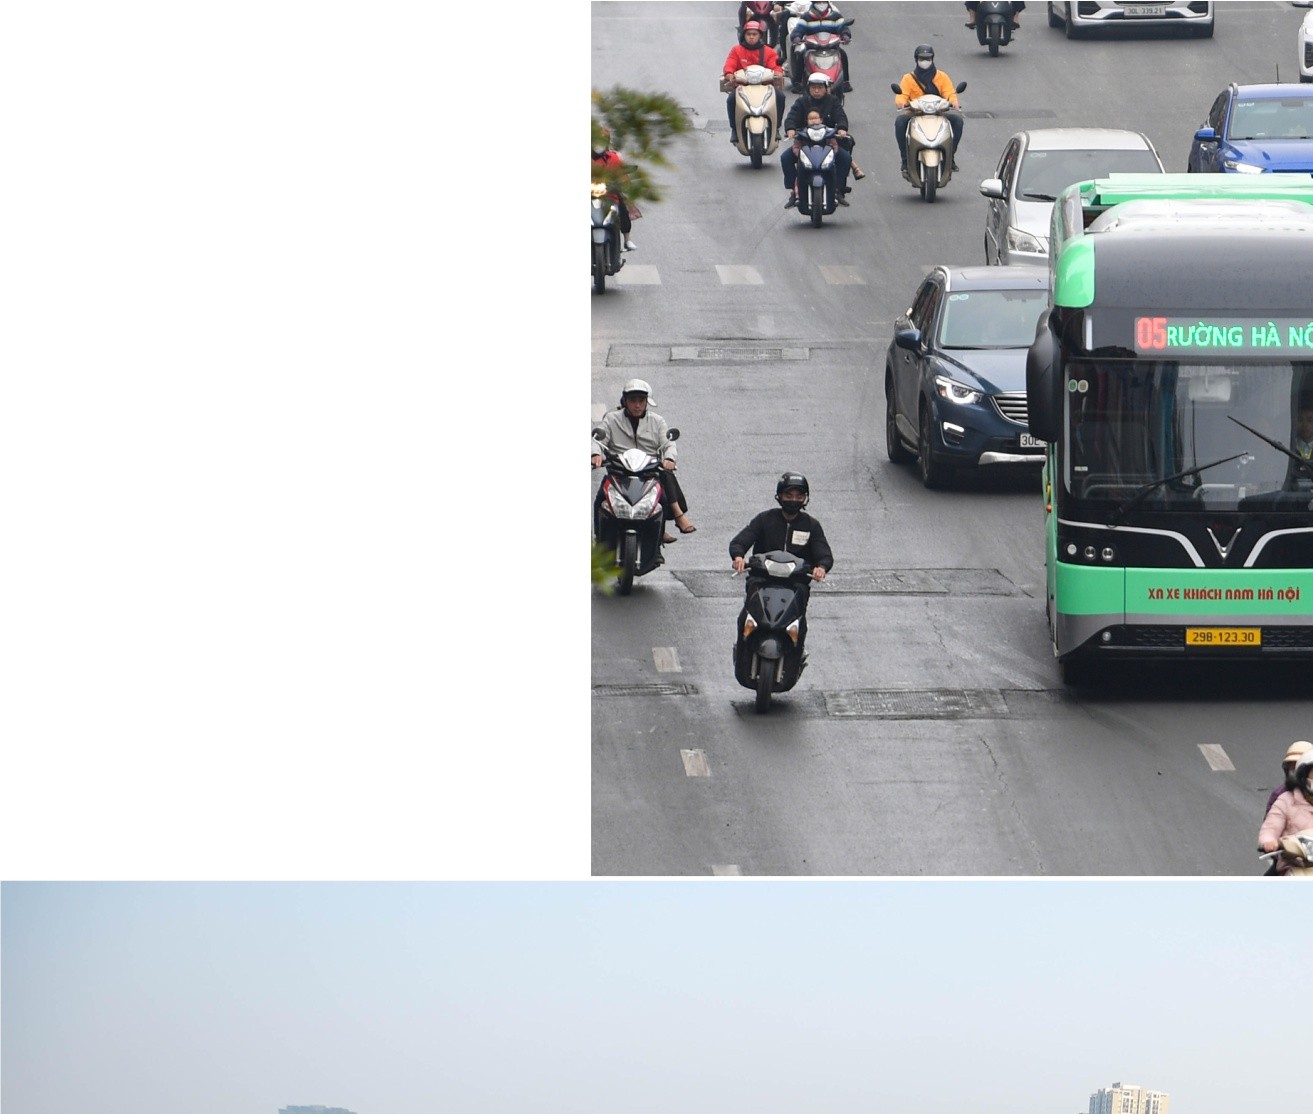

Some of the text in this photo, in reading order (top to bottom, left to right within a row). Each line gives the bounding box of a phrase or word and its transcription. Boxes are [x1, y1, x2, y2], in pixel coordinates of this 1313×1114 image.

[1137, 316, 1167, 350] 05
[1251, 322, 1281, 347] HÀ
[1166, 588, 1180, 600] XE
[1183, 586, 1222, 600] KHÁCH
